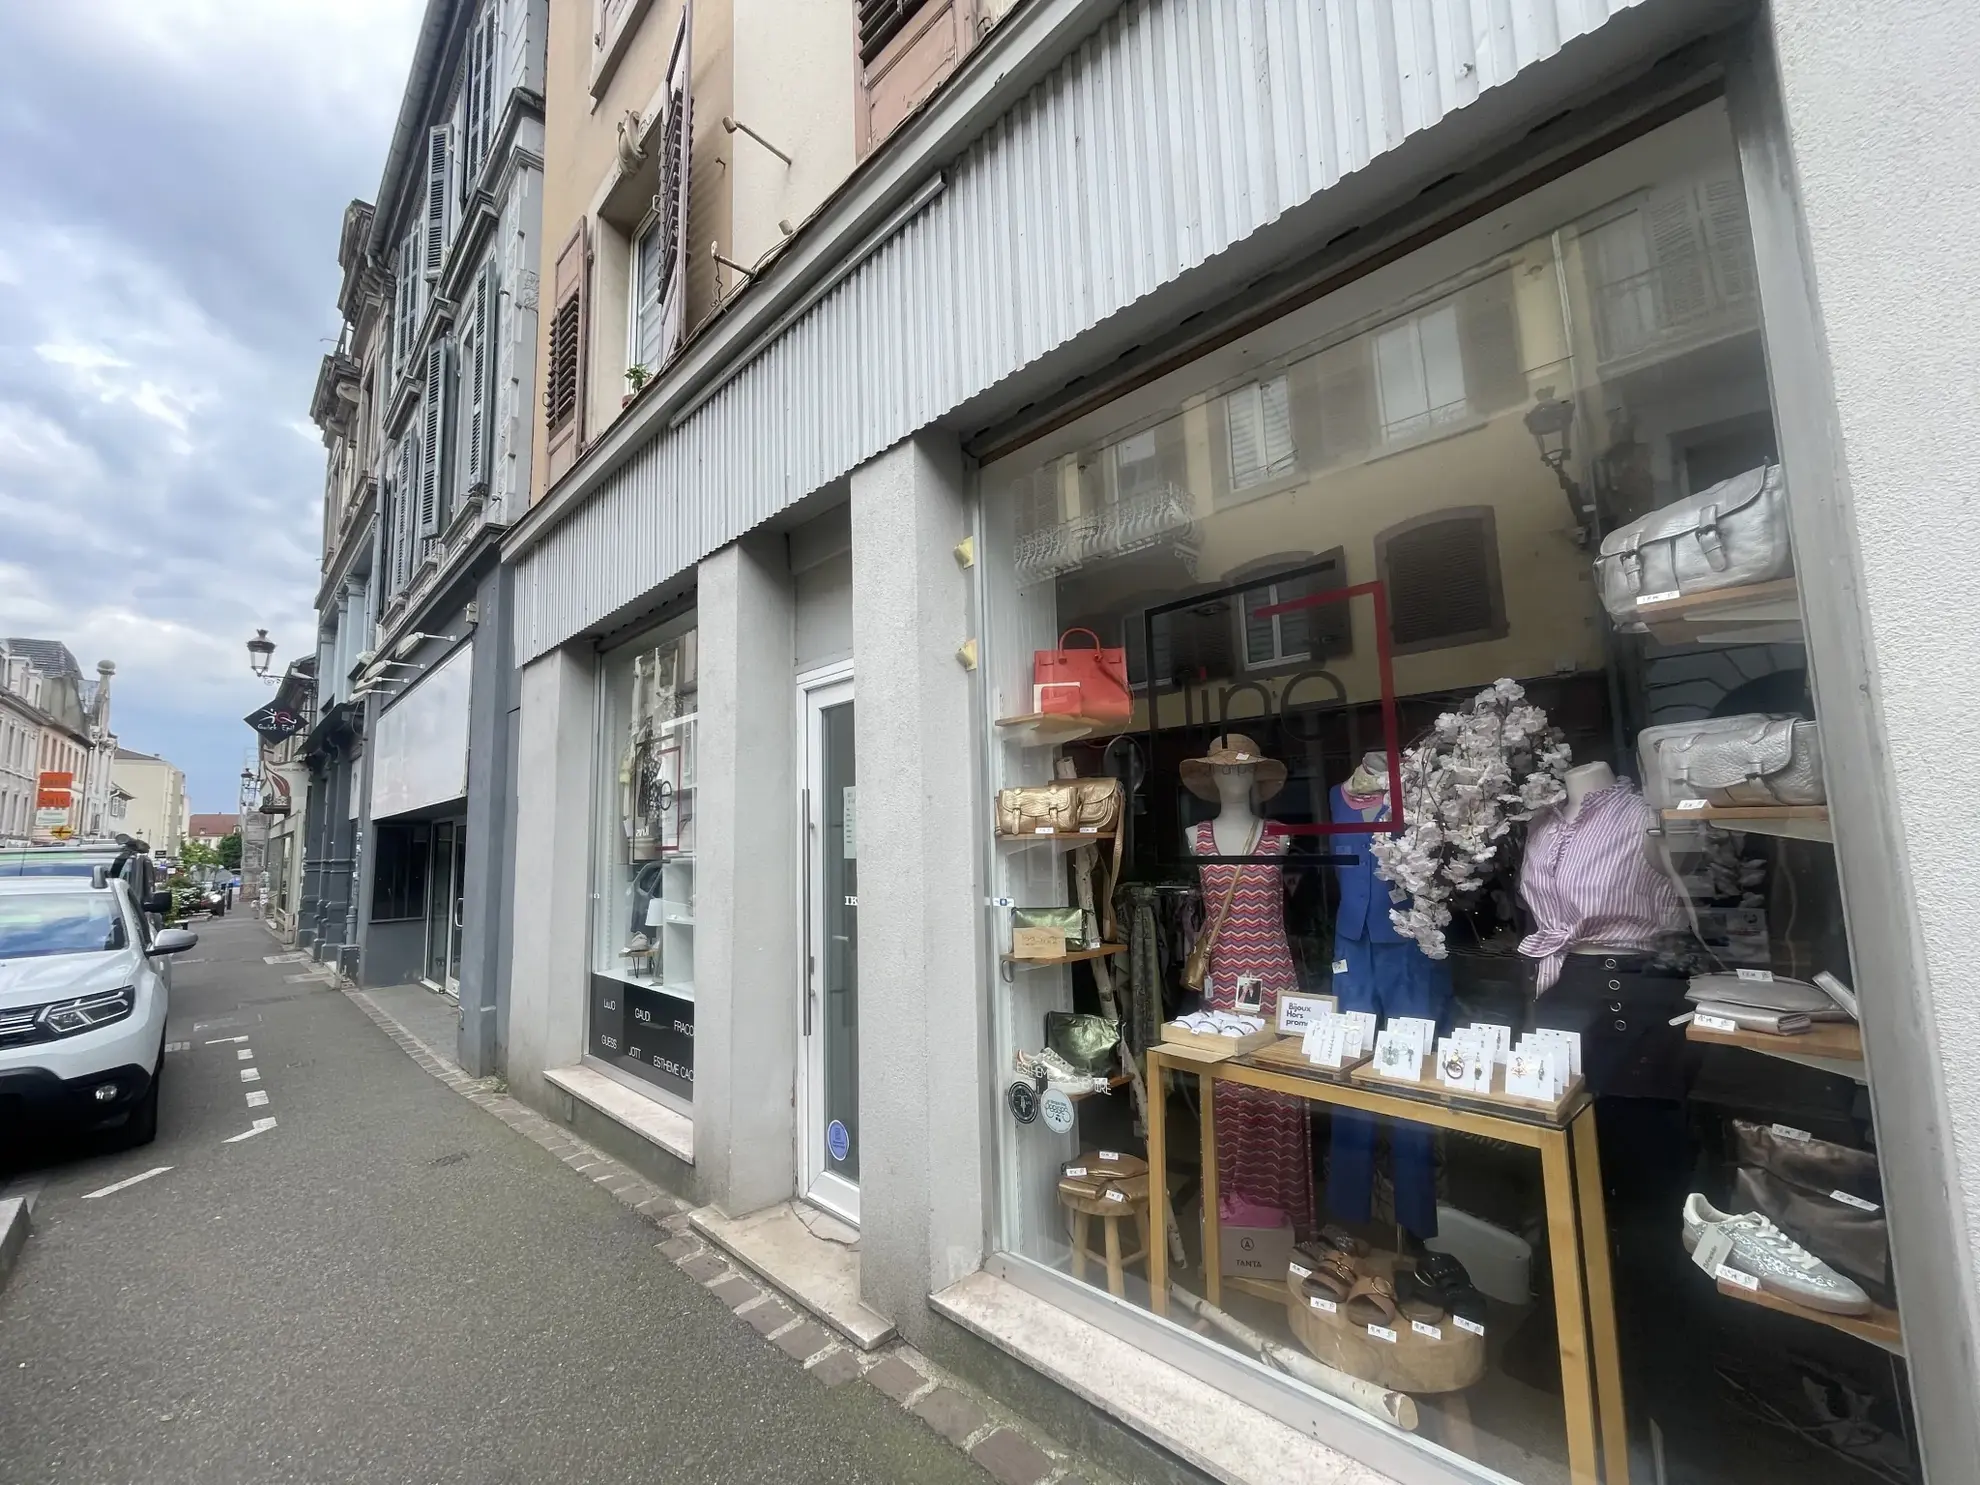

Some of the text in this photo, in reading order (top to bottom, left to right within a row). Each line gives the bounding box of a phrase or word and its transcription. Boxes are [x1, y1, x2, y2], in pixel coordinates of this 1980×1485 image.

[1289, 1002, 1312, 1012] Bijoux
[1286, 1010, 1304, 1019] Hors
[1285, 1019, 1309, 1027] prom
[601, 1034, 618, 1050] GUESS
[628, 1046, 642, 1060] JOTT
[653, 1055, 680, 1077] ESTHEME
[1236, 1259, 1262, 1268] TANTA
